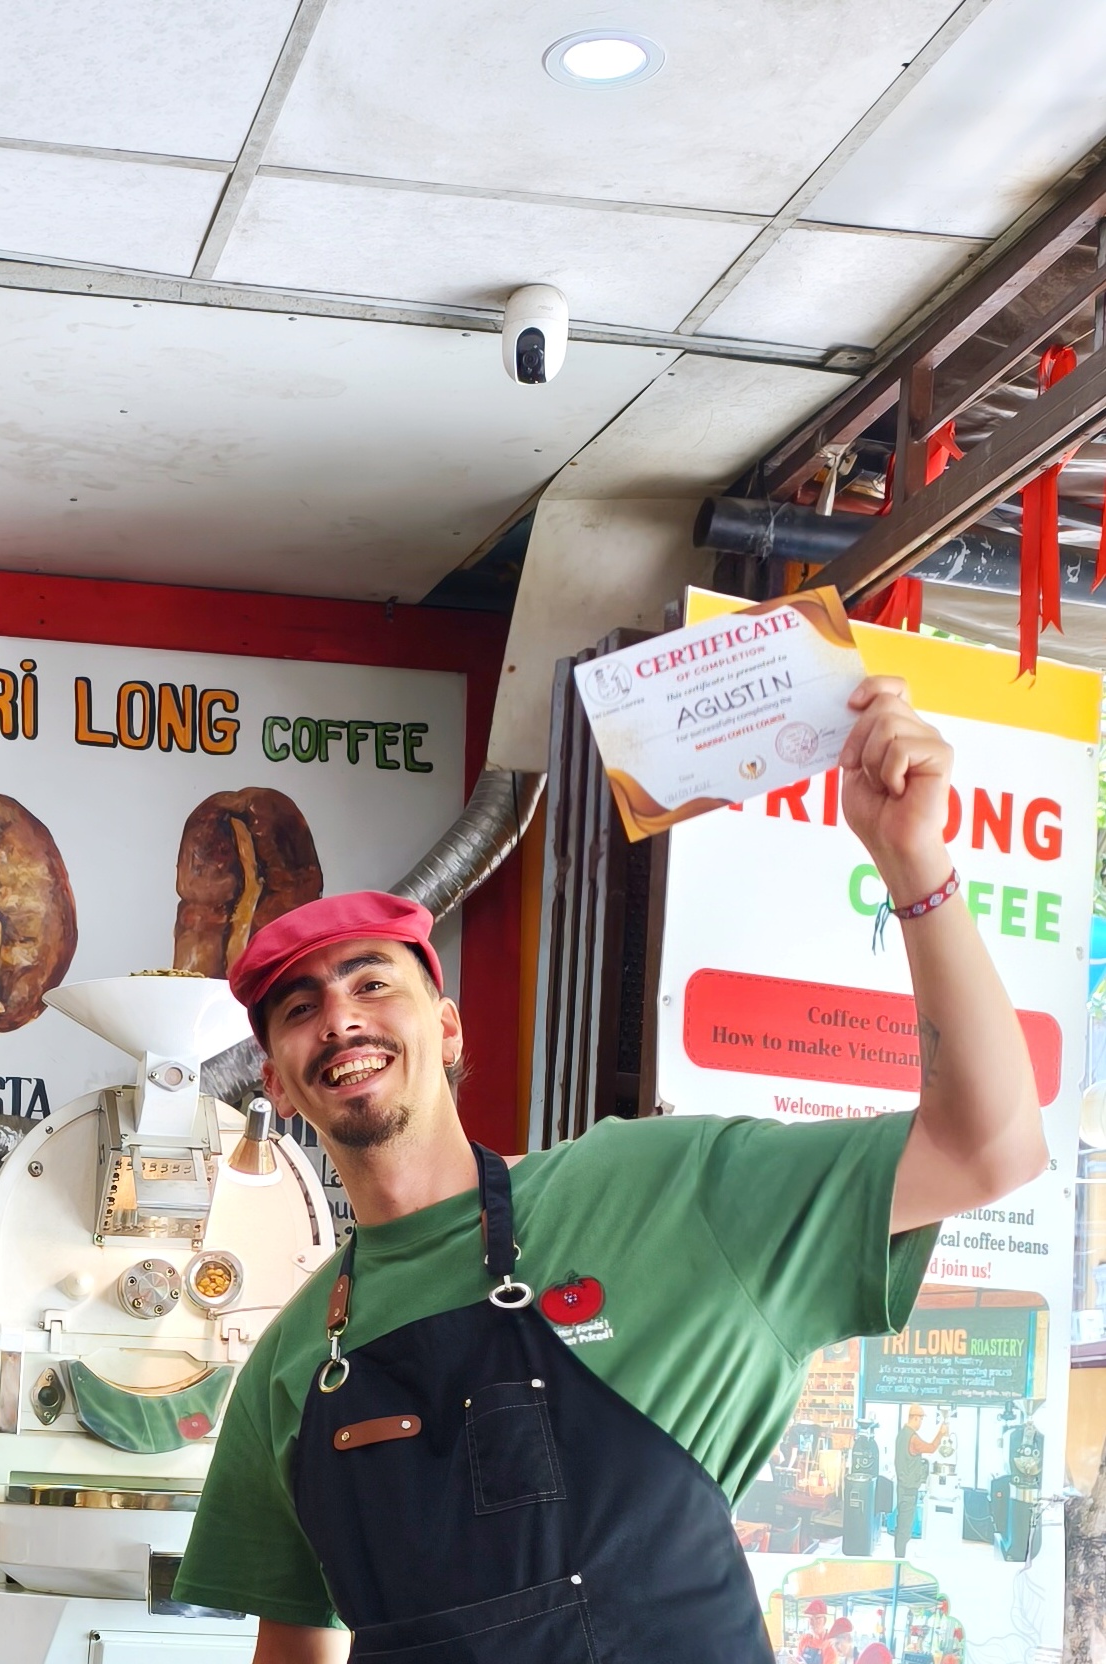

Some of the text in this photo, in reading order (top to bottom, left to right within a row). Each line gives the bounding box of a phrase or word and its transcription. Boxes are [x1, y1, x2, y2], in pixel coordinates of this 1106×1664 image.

[635, 611, 799, 680] CERTIFICATE
[692, 645, 766, 675] COMPLETION
[677, 671, 792, 729] AGUSTIN
[74, 676, 241, 755] LONG
[262, 715, 433, 773] COFFEE
[848, 864, 1063, 943] CFEE
[808, 1006, 870, 1030] Coffee
[712, 1025, 755, 1047] How
[762, 1033, 782, 1050] to
[788, 1038, 842, 1058] make
[774, 1095, 843, 1117] Welcome
[1008, 1209, 1034, 1225] and
[964, 1232, 1005, 1251] coffee
[1008, 1235, 1049, 1255] beans
[941, 1259, 968, 1278] join
[971, 1262, 992, 1279] us!
[914, 1328, 967, 1355] LONG
[971, 1338, 1025, 1357] ROASTERY
